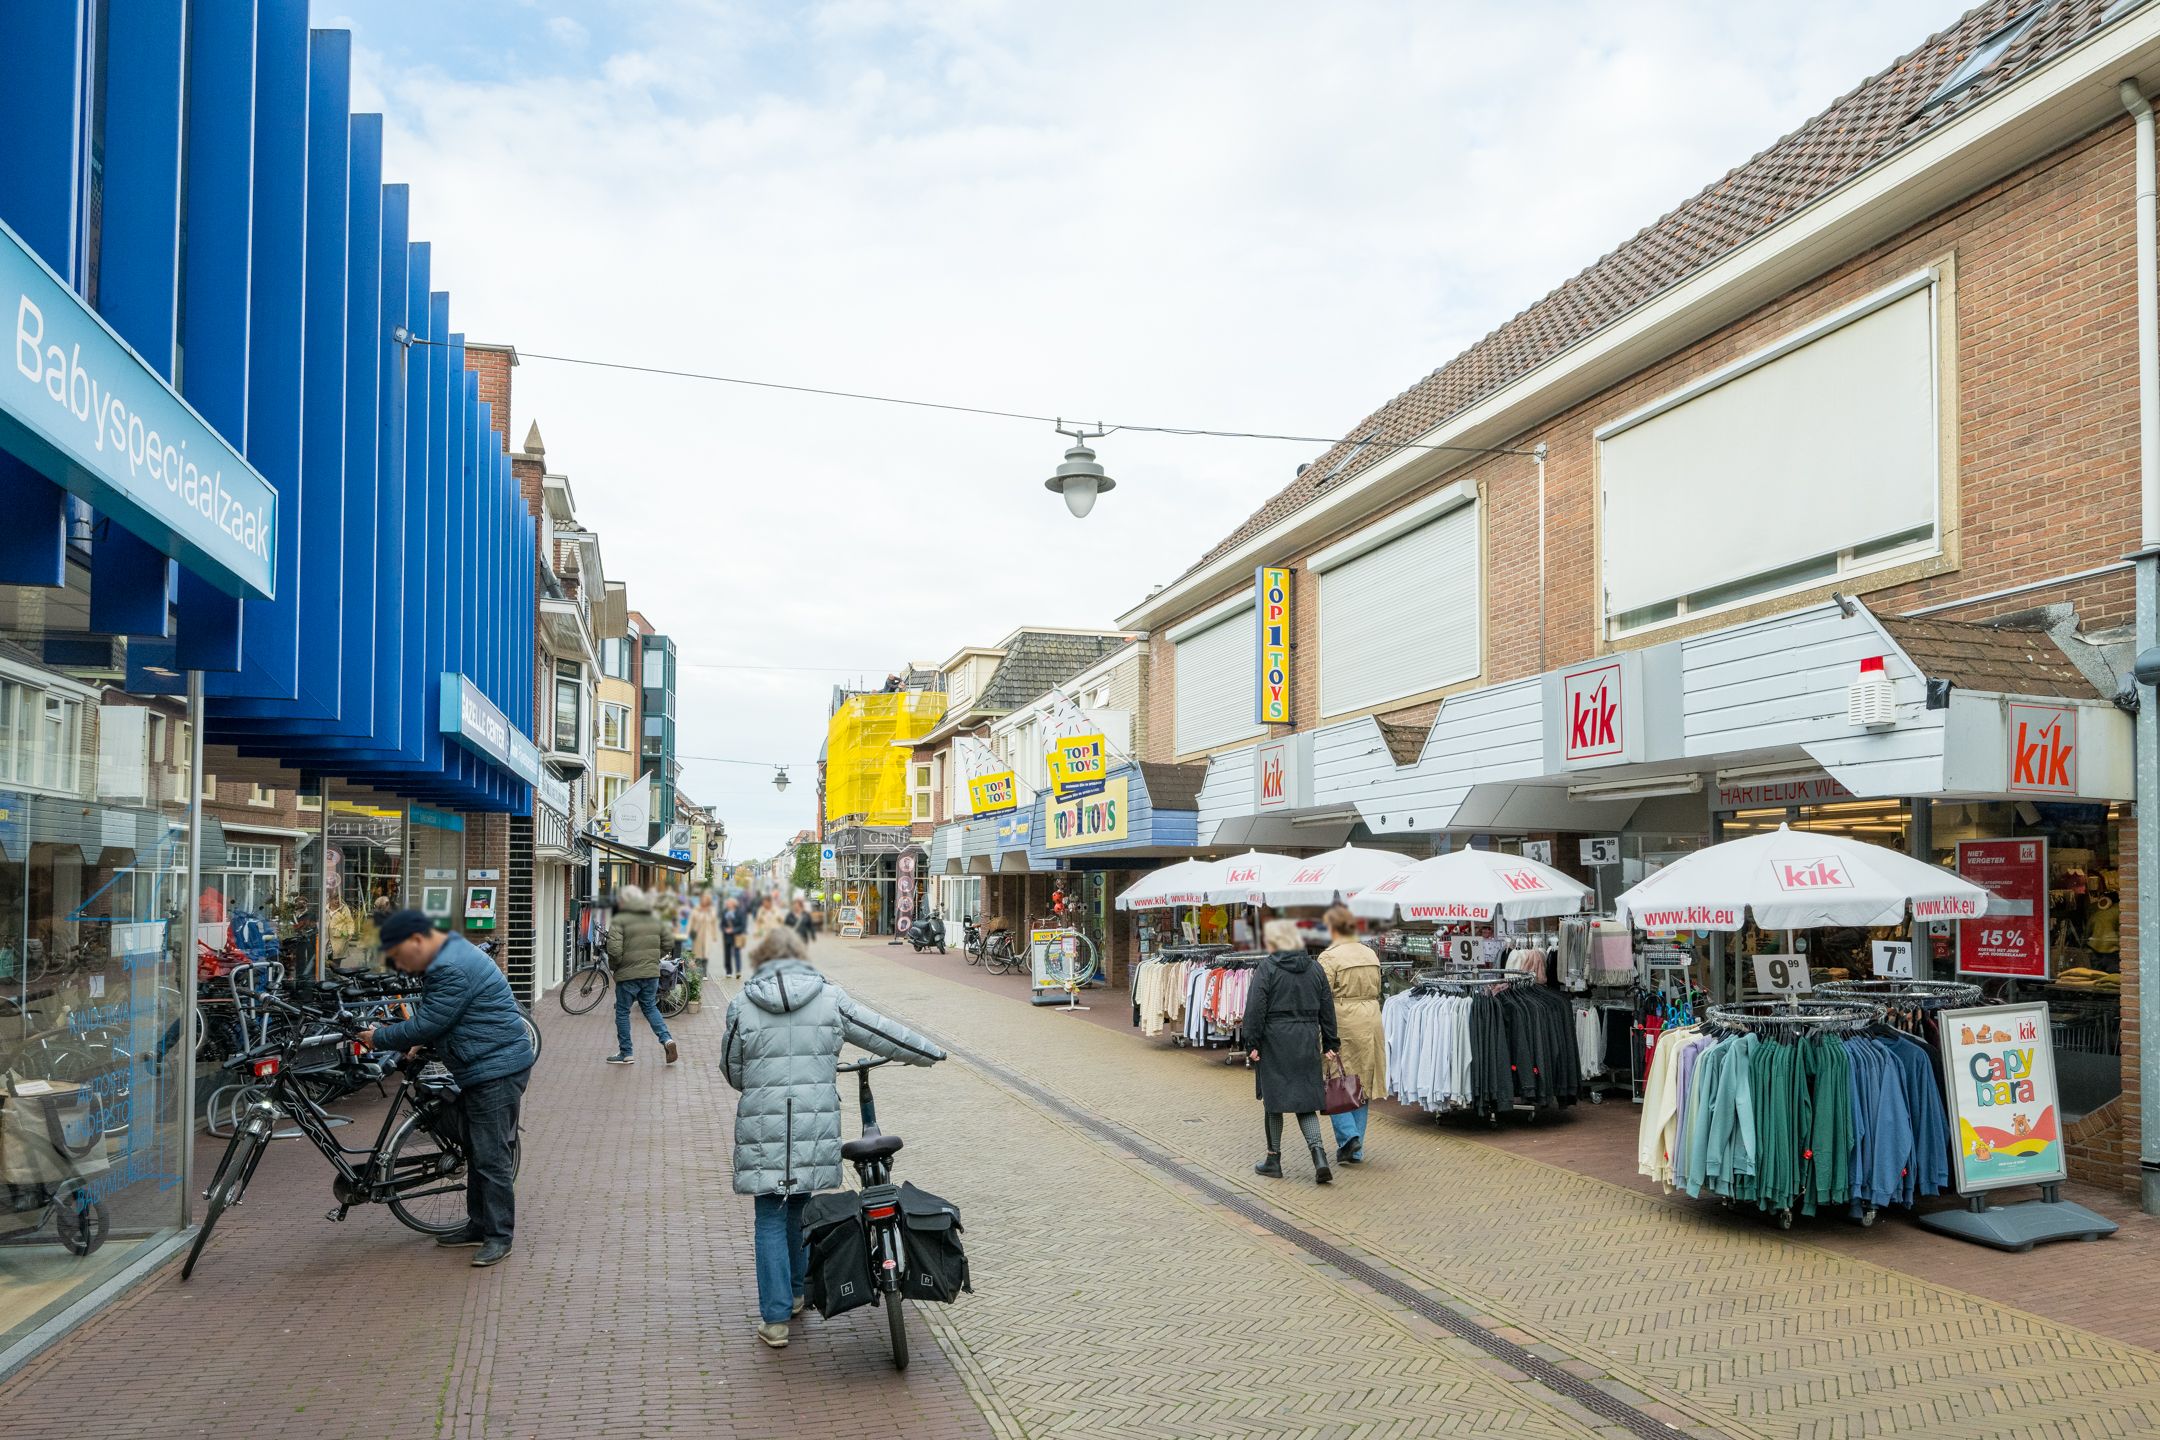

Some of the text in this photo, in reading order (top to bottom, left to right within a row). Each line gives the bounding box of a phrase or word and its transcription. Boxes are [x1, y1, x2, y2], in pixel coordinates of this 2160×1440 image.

[16, 294, 269, 561] Babyspeciaalzaak
[1268, 571, 1284, 718] TOP 1 TOYS
[1571, 675, 1617, 749] kik
[1064, 742, 1100, 760] TOP 1
[2013, 713, 2073, 786] kik
[1068, 759, 1100, 773] TOYS
[1263, 752, 1283, 798] kik
[984, 781, 1004, 793] TOP
[987, 790, 1012, 803] TOYS
[1053, 810, 1075, 840] TOP
[1084, 800, 1116, 834] TOYS
[1229, 868, 1257, 882] kik
[1504, 868, 1545, 891] kik
[1784, 858, 1842, 887] kik
[1411, 903, 1489, 919] www.kik.eu
[1644, 906, 1735, 926] www.kik.eu
[1916, 896, 1975, 916] www.kik.eu
[2019, 1019, 2037, 1041] kik
[1969, 1047, 2035, 1083] Capy
[1975, 1079, 2035, 1107] bara
